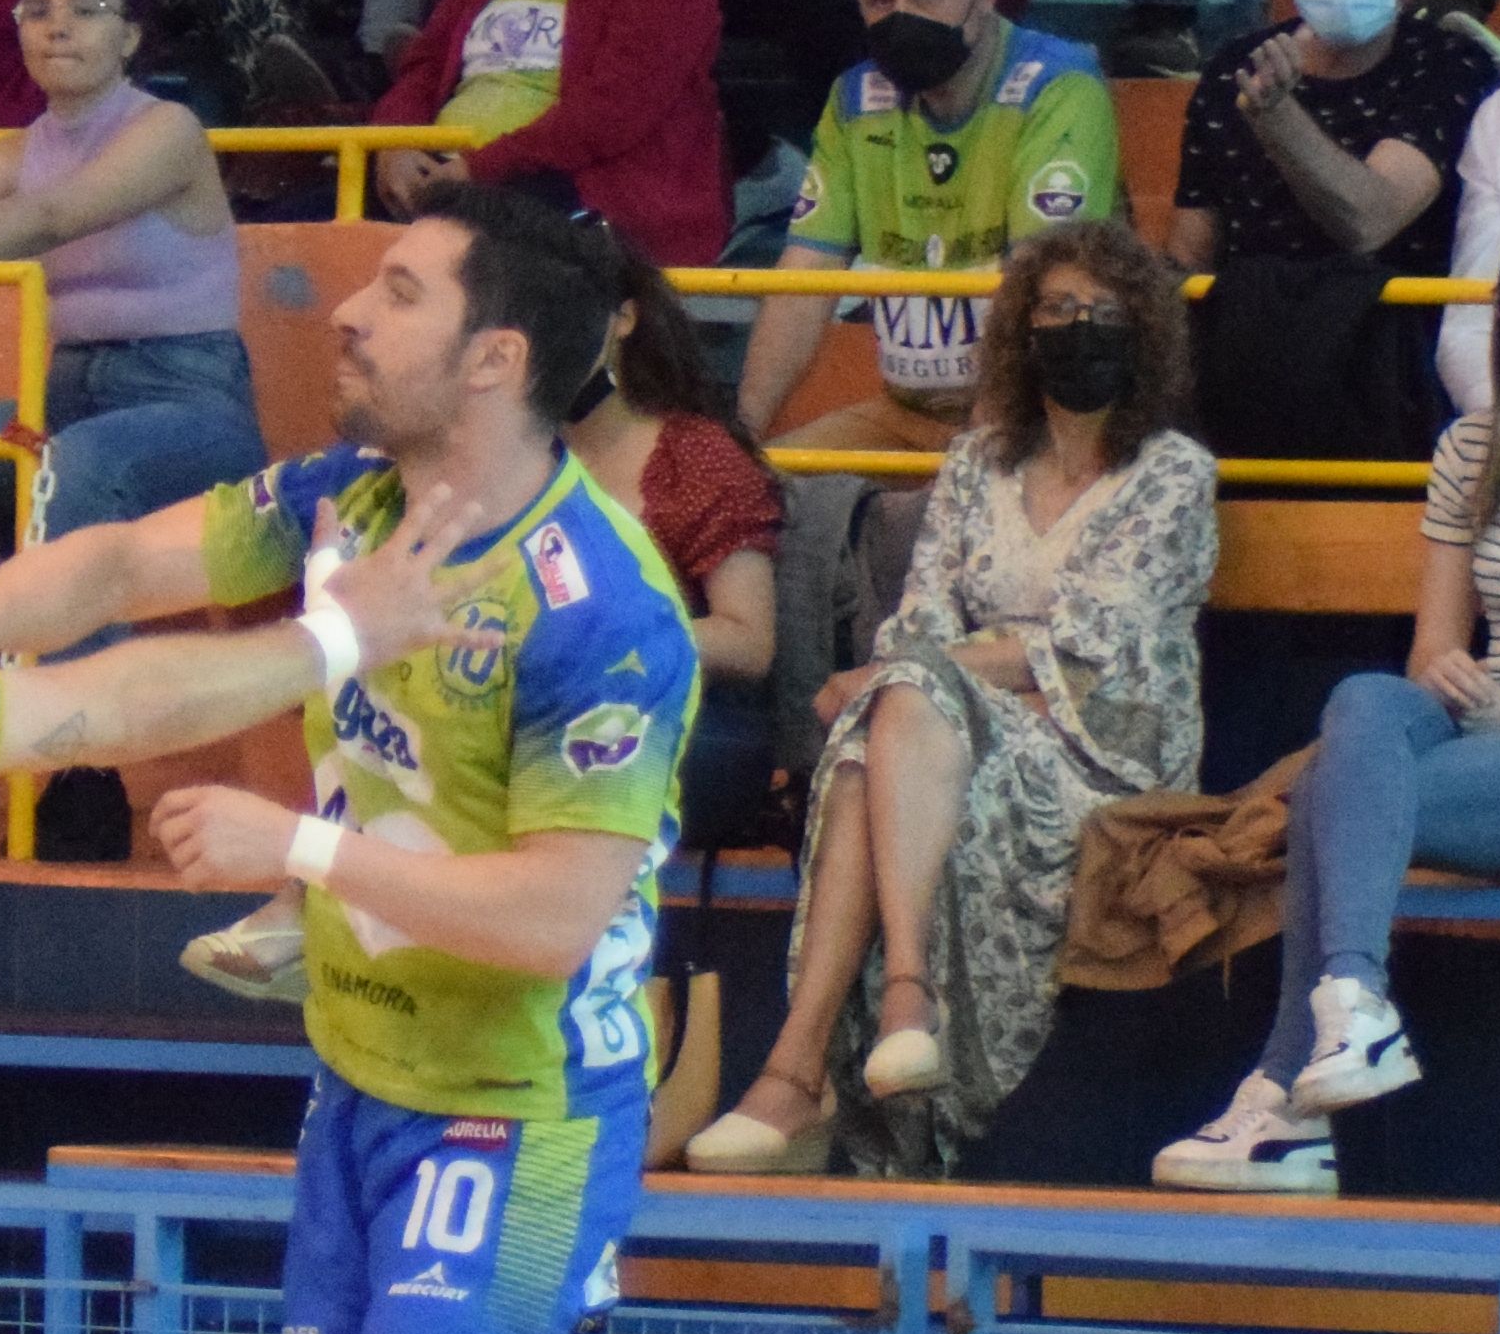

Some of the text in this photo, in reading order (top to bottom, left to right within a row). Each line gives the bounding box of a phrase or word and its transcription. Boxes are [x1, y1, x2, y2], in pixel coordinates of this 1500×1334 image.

[442, 1119, 508, 1140] AURELIA
[401, 1158, 496, 1255] 10
[386, 1282, 471, 1303] MERCURY
